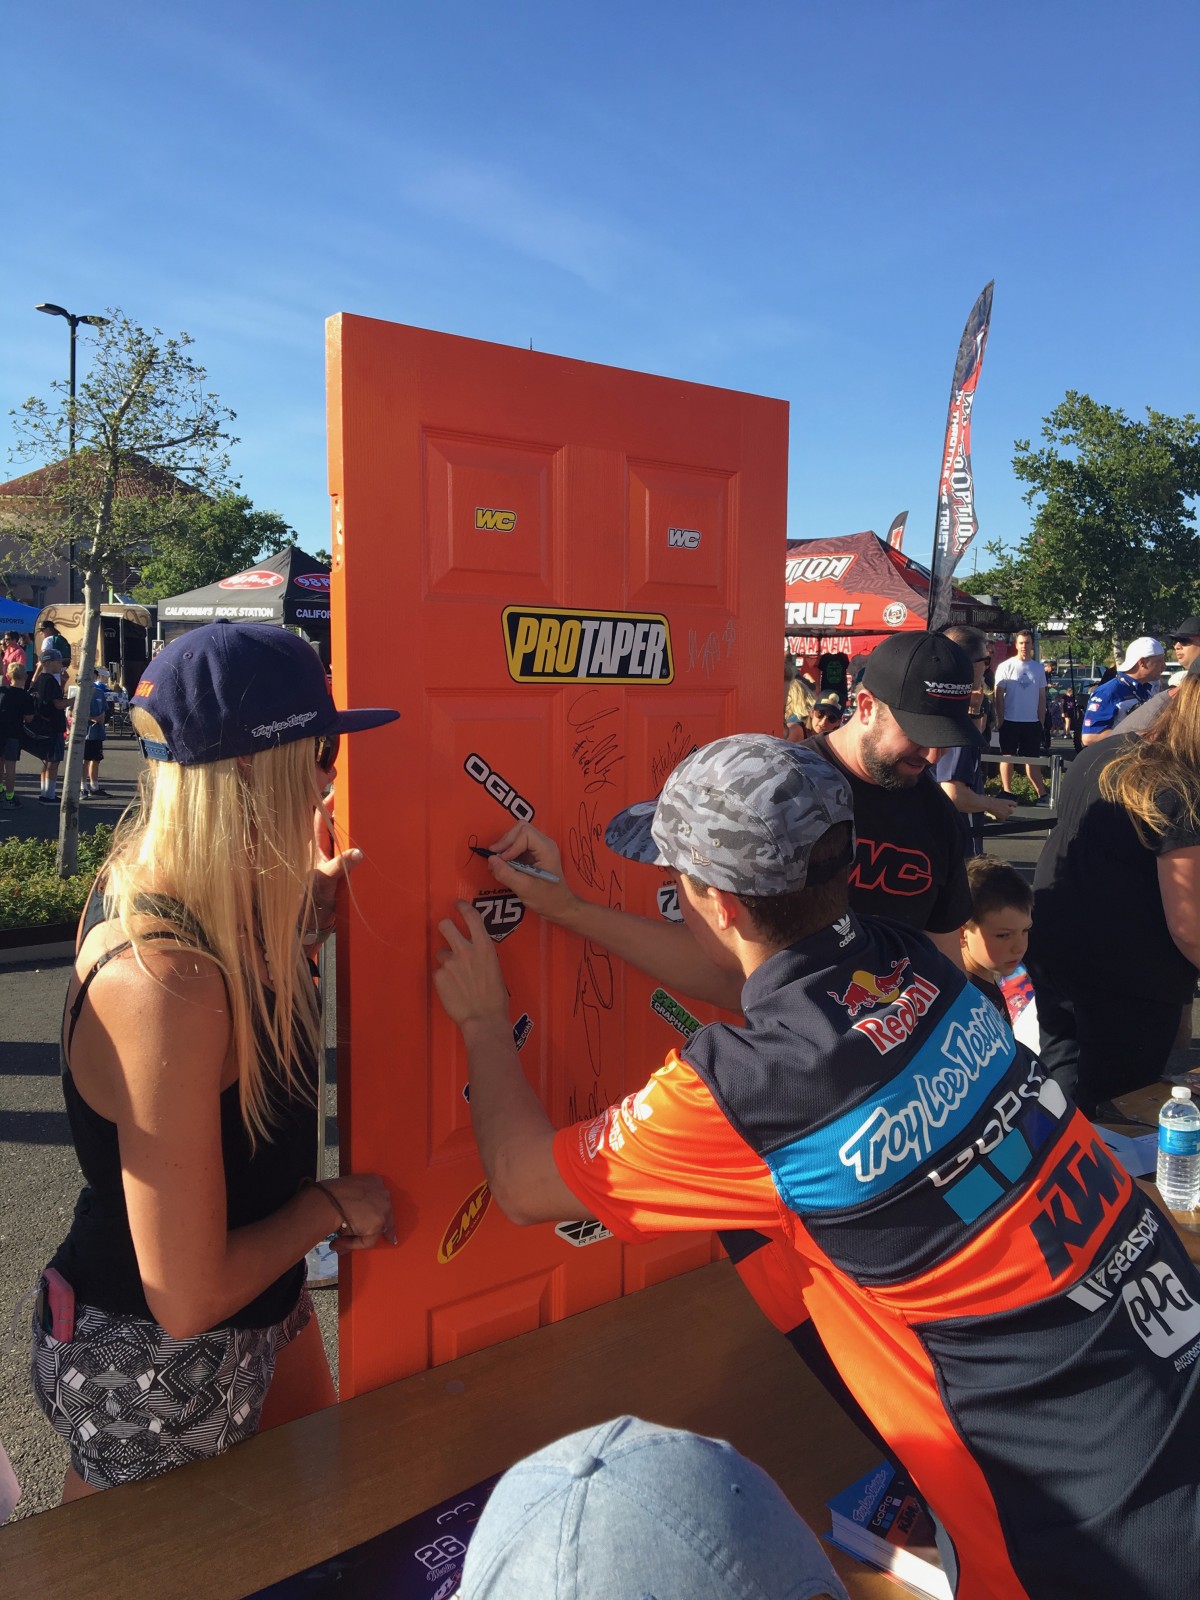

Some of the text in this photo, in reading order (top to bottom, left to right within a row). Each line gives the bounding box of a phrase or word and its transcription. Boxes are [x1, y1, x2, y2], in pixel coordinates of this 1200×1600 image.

[475, 508, 517, 532] WC
[668, 528, 701, 549] WC
[298, 577, 321, 587] 98
[165, 606, 274, 618] CALIFORNIA'S ROCK STATION
[785, 602, 861, 626] RUST
[511, 617, 667, 680] PROTAPER
[789, 636, 852, 655] YAMAHA
[464, 753, 535, 823] OGIO
[475, 898, 522, 924] 715
[660, 889, 680, 912] 71
[839, 1107, 932, 1182] Troy
[914, 1068, 969, 1128] Lee
[446, 1183, 488, 1259] FMF
[1029, 1139, 1126, 1281] KTM
[871, 1496, 893, 1526] GoPro
[415, 1535, 467, 1570] 26
